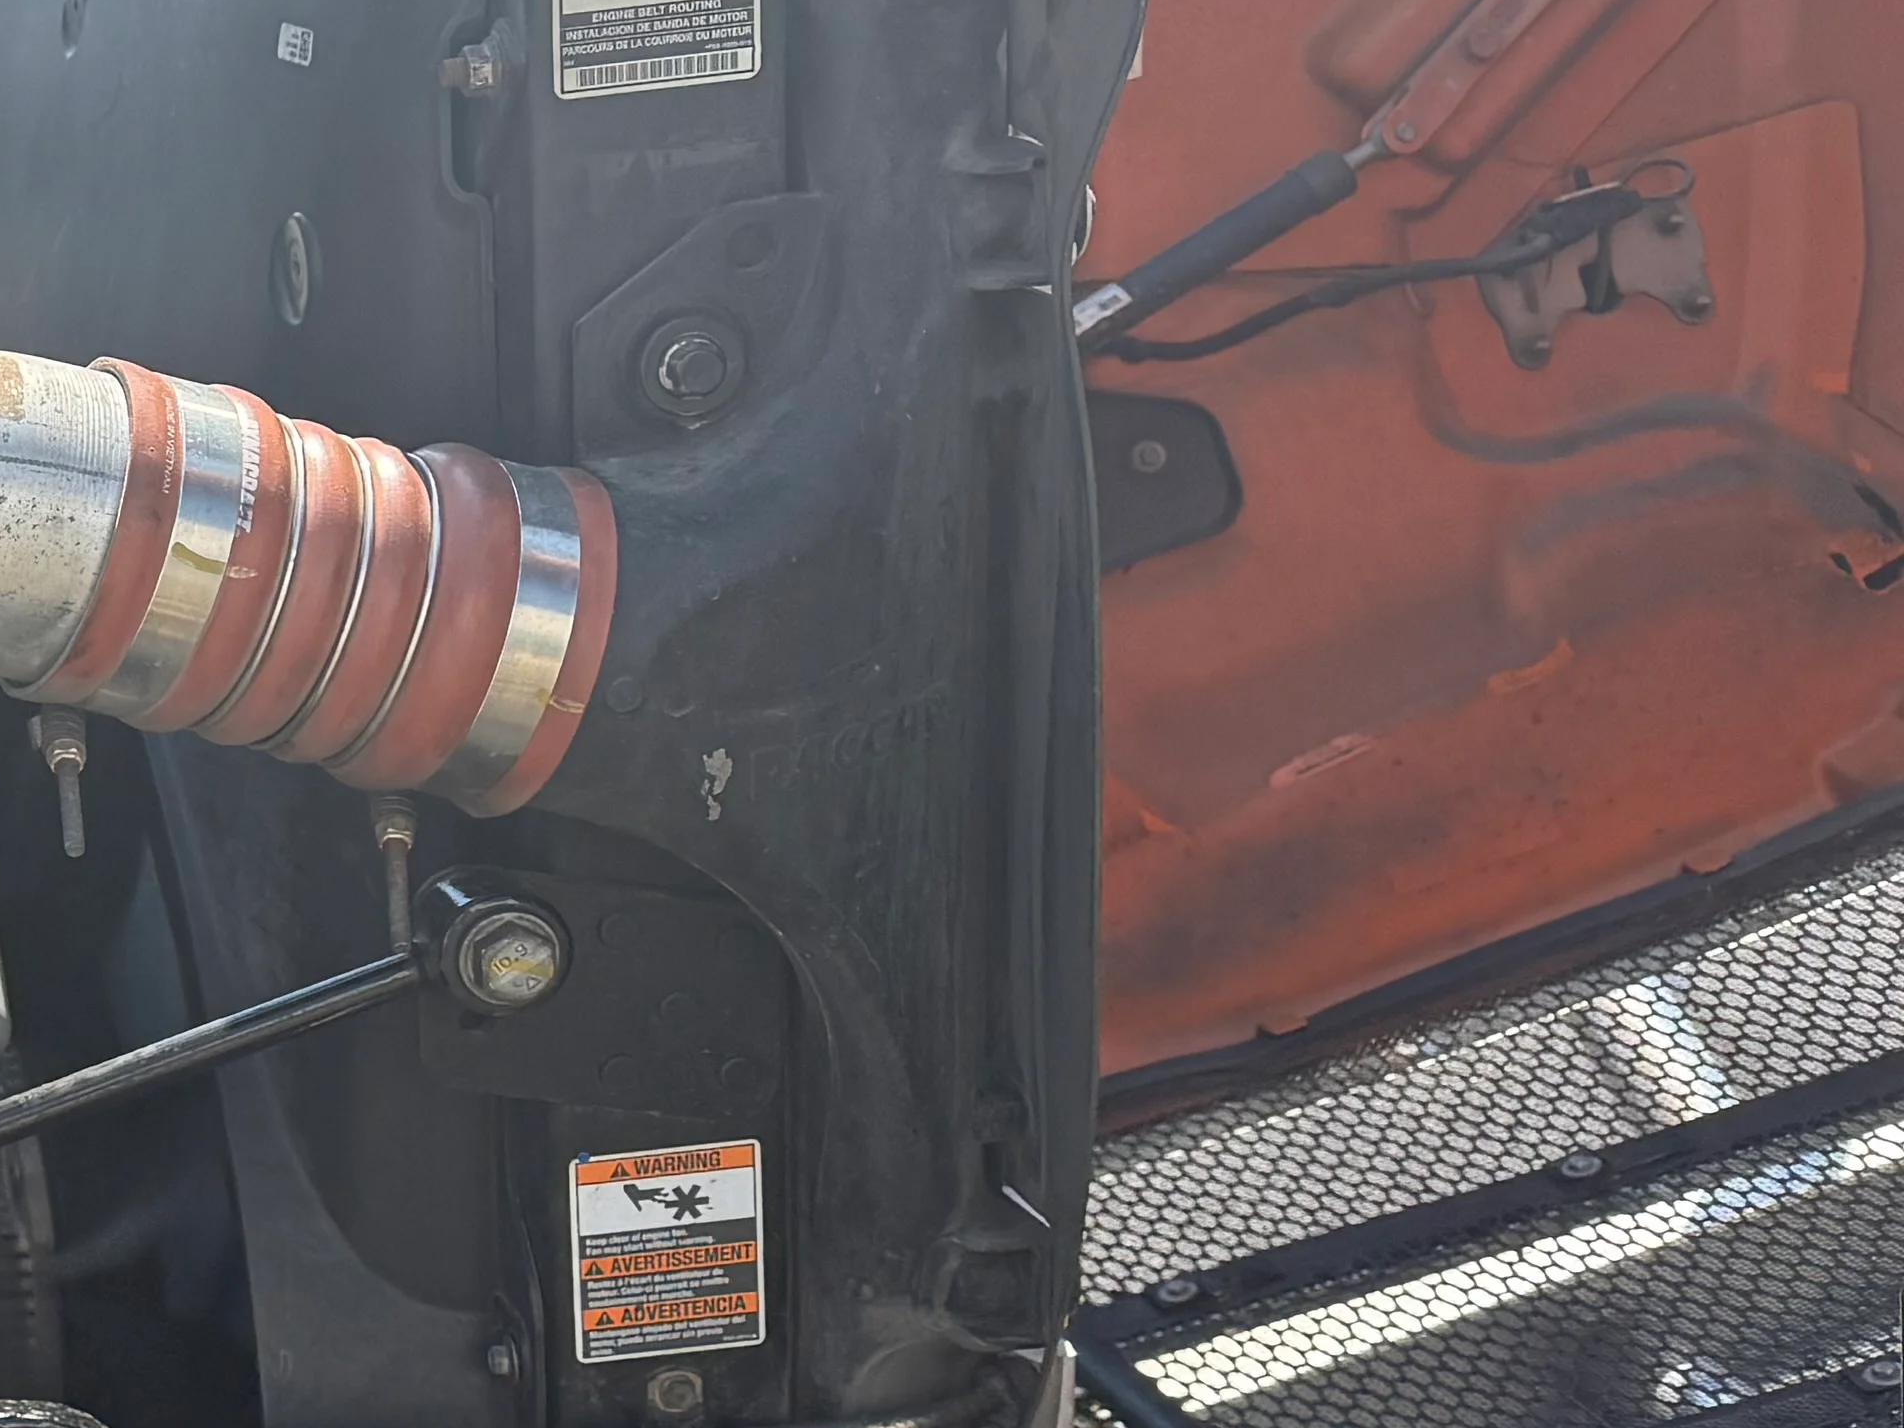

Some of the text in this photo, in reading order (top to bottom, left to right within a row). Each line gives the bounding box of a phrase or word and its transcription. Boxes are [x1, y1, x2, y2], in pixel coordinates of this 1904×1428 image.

[592, 8, 635, 22] ENGINE
[638, 3, 664, 18] BELT
[637, 23, 650, 34] DE
[654, 18, 690, 32] BANDA
[692, 16, 706, 26] DE
[710, 11, 748, 25] MOTOR
[712, 26, 752, 39] MOTEUR
[162, 438, 175, 494] VIETNAM
[492, 943, 528, 972] 10.9
[634, 1151, 721, 1175] WARNING
[610, 1244, 753, 1274] AVERTISSEMENT
[621, 1295, 746, 1324] ADVERTENCIA
